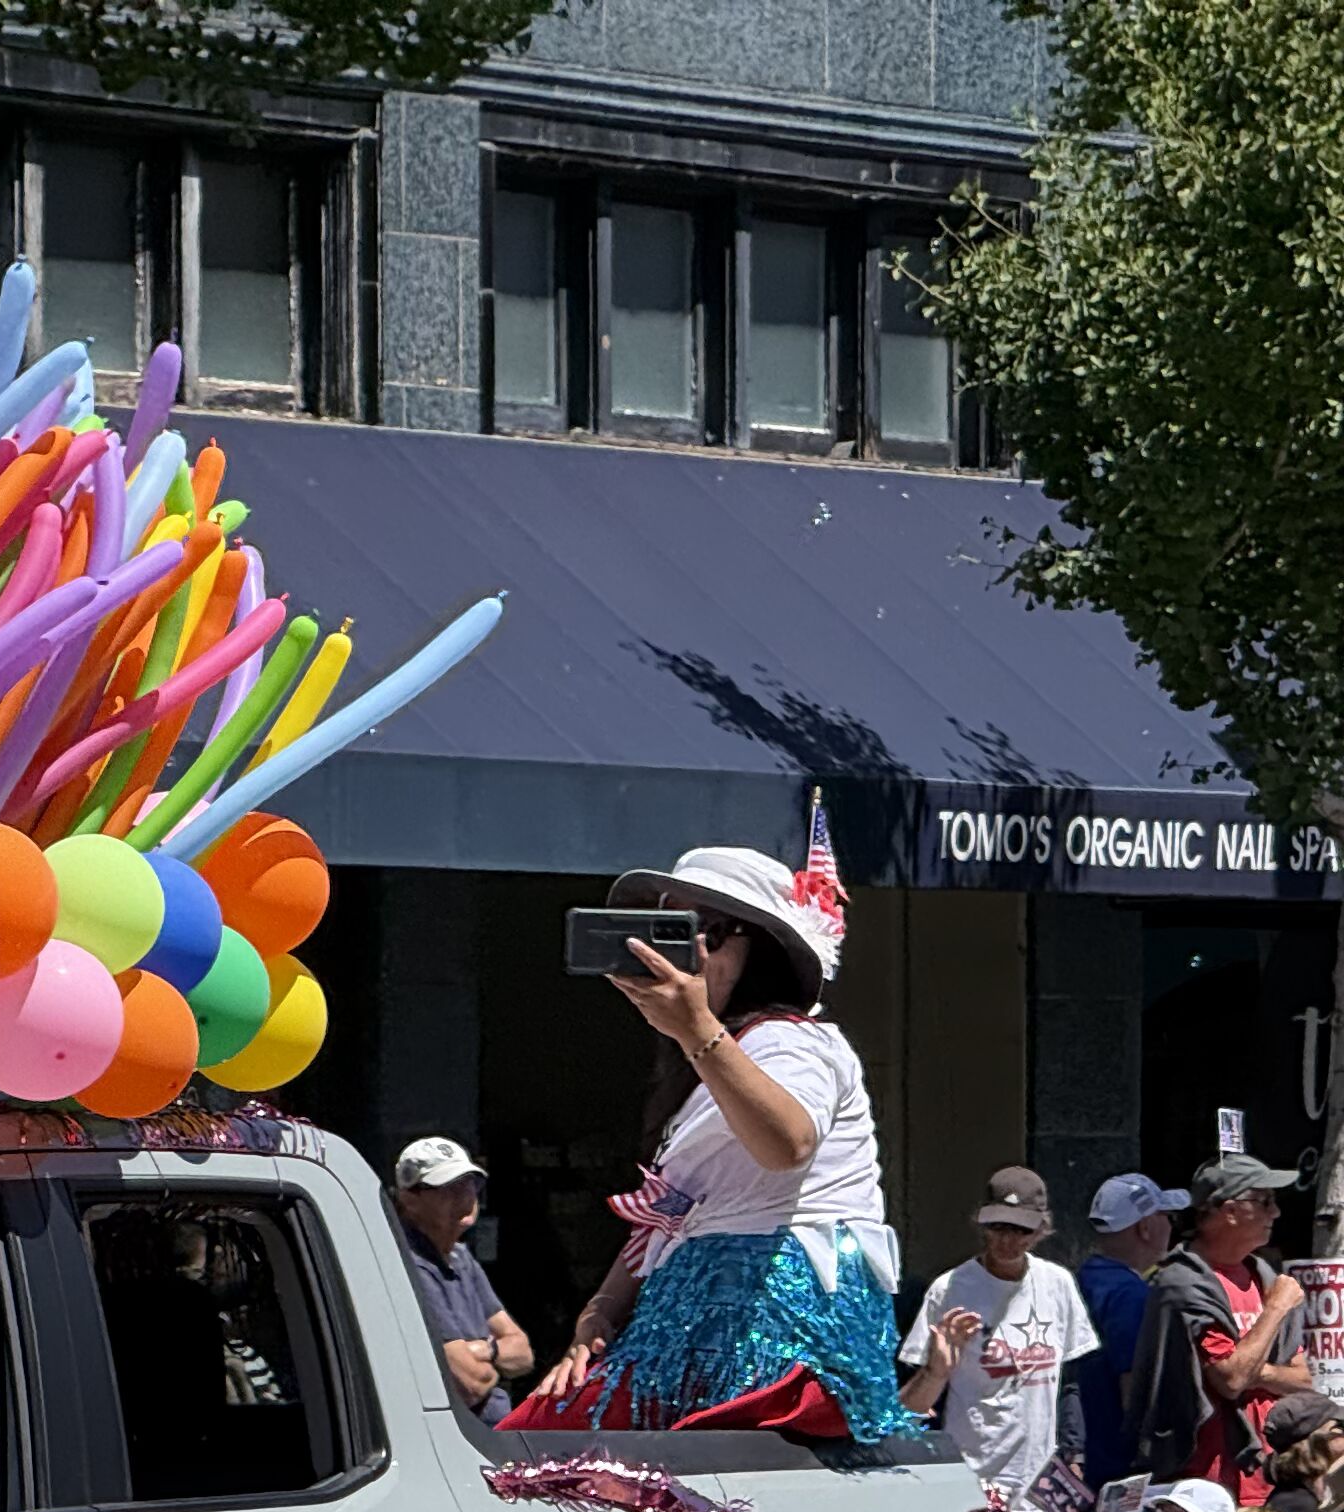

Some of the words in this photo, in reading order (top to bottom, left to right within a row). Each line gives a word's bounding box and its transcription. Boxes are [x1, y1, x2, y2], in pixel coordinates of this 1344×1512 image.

[938, 810, 1052, 864] TOMO'S
[1065, 815, 1202, 870] ORGANIC
[1215, 822, 1279, 872] NAIL
[1289, 825, 1339, 873] SPA
